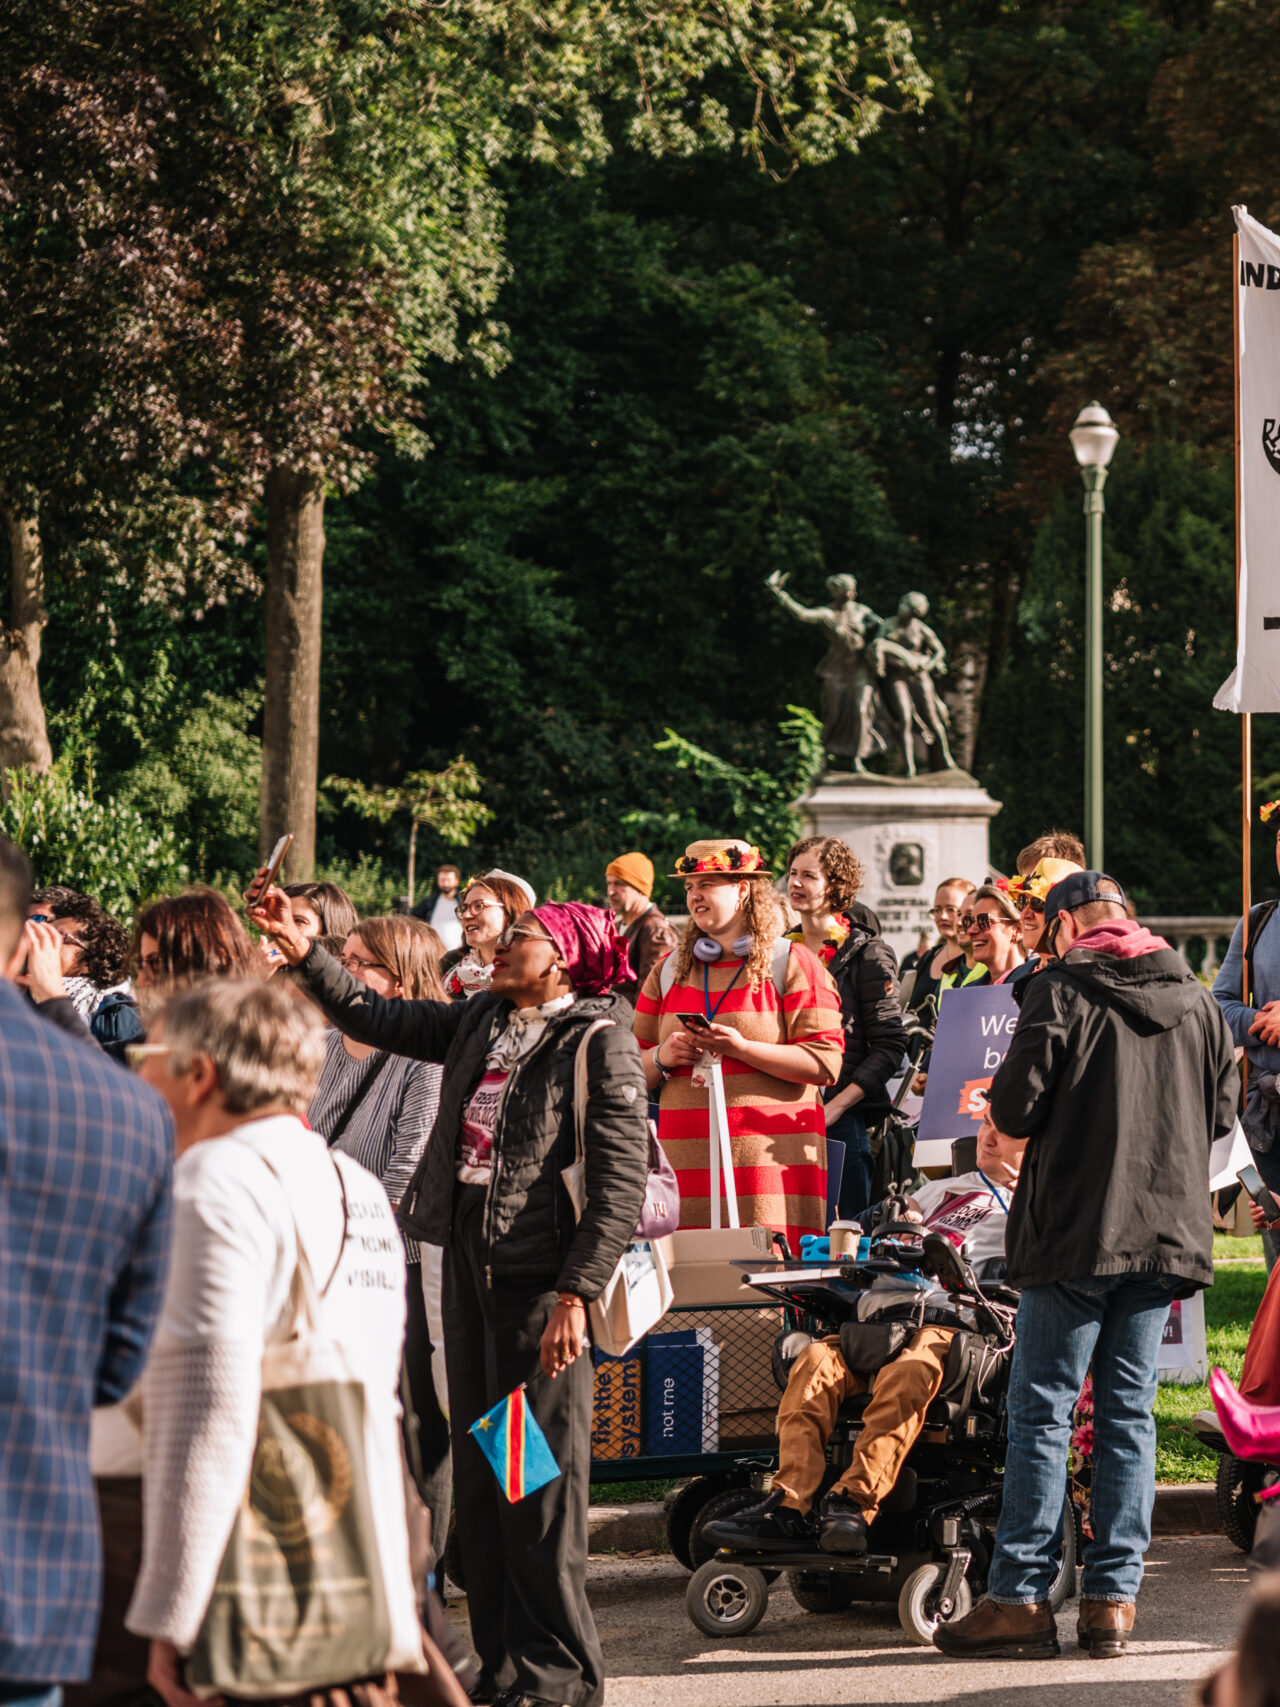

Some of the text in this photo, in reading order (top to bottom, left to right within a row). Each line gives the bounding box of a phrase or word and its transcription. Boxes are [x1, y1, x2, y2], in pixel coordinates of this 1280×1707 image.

[591, 1373, 611, 1443] fix the
[619, 1364, 640, 1456] system
[662, 1378, 675, 1437] not me
